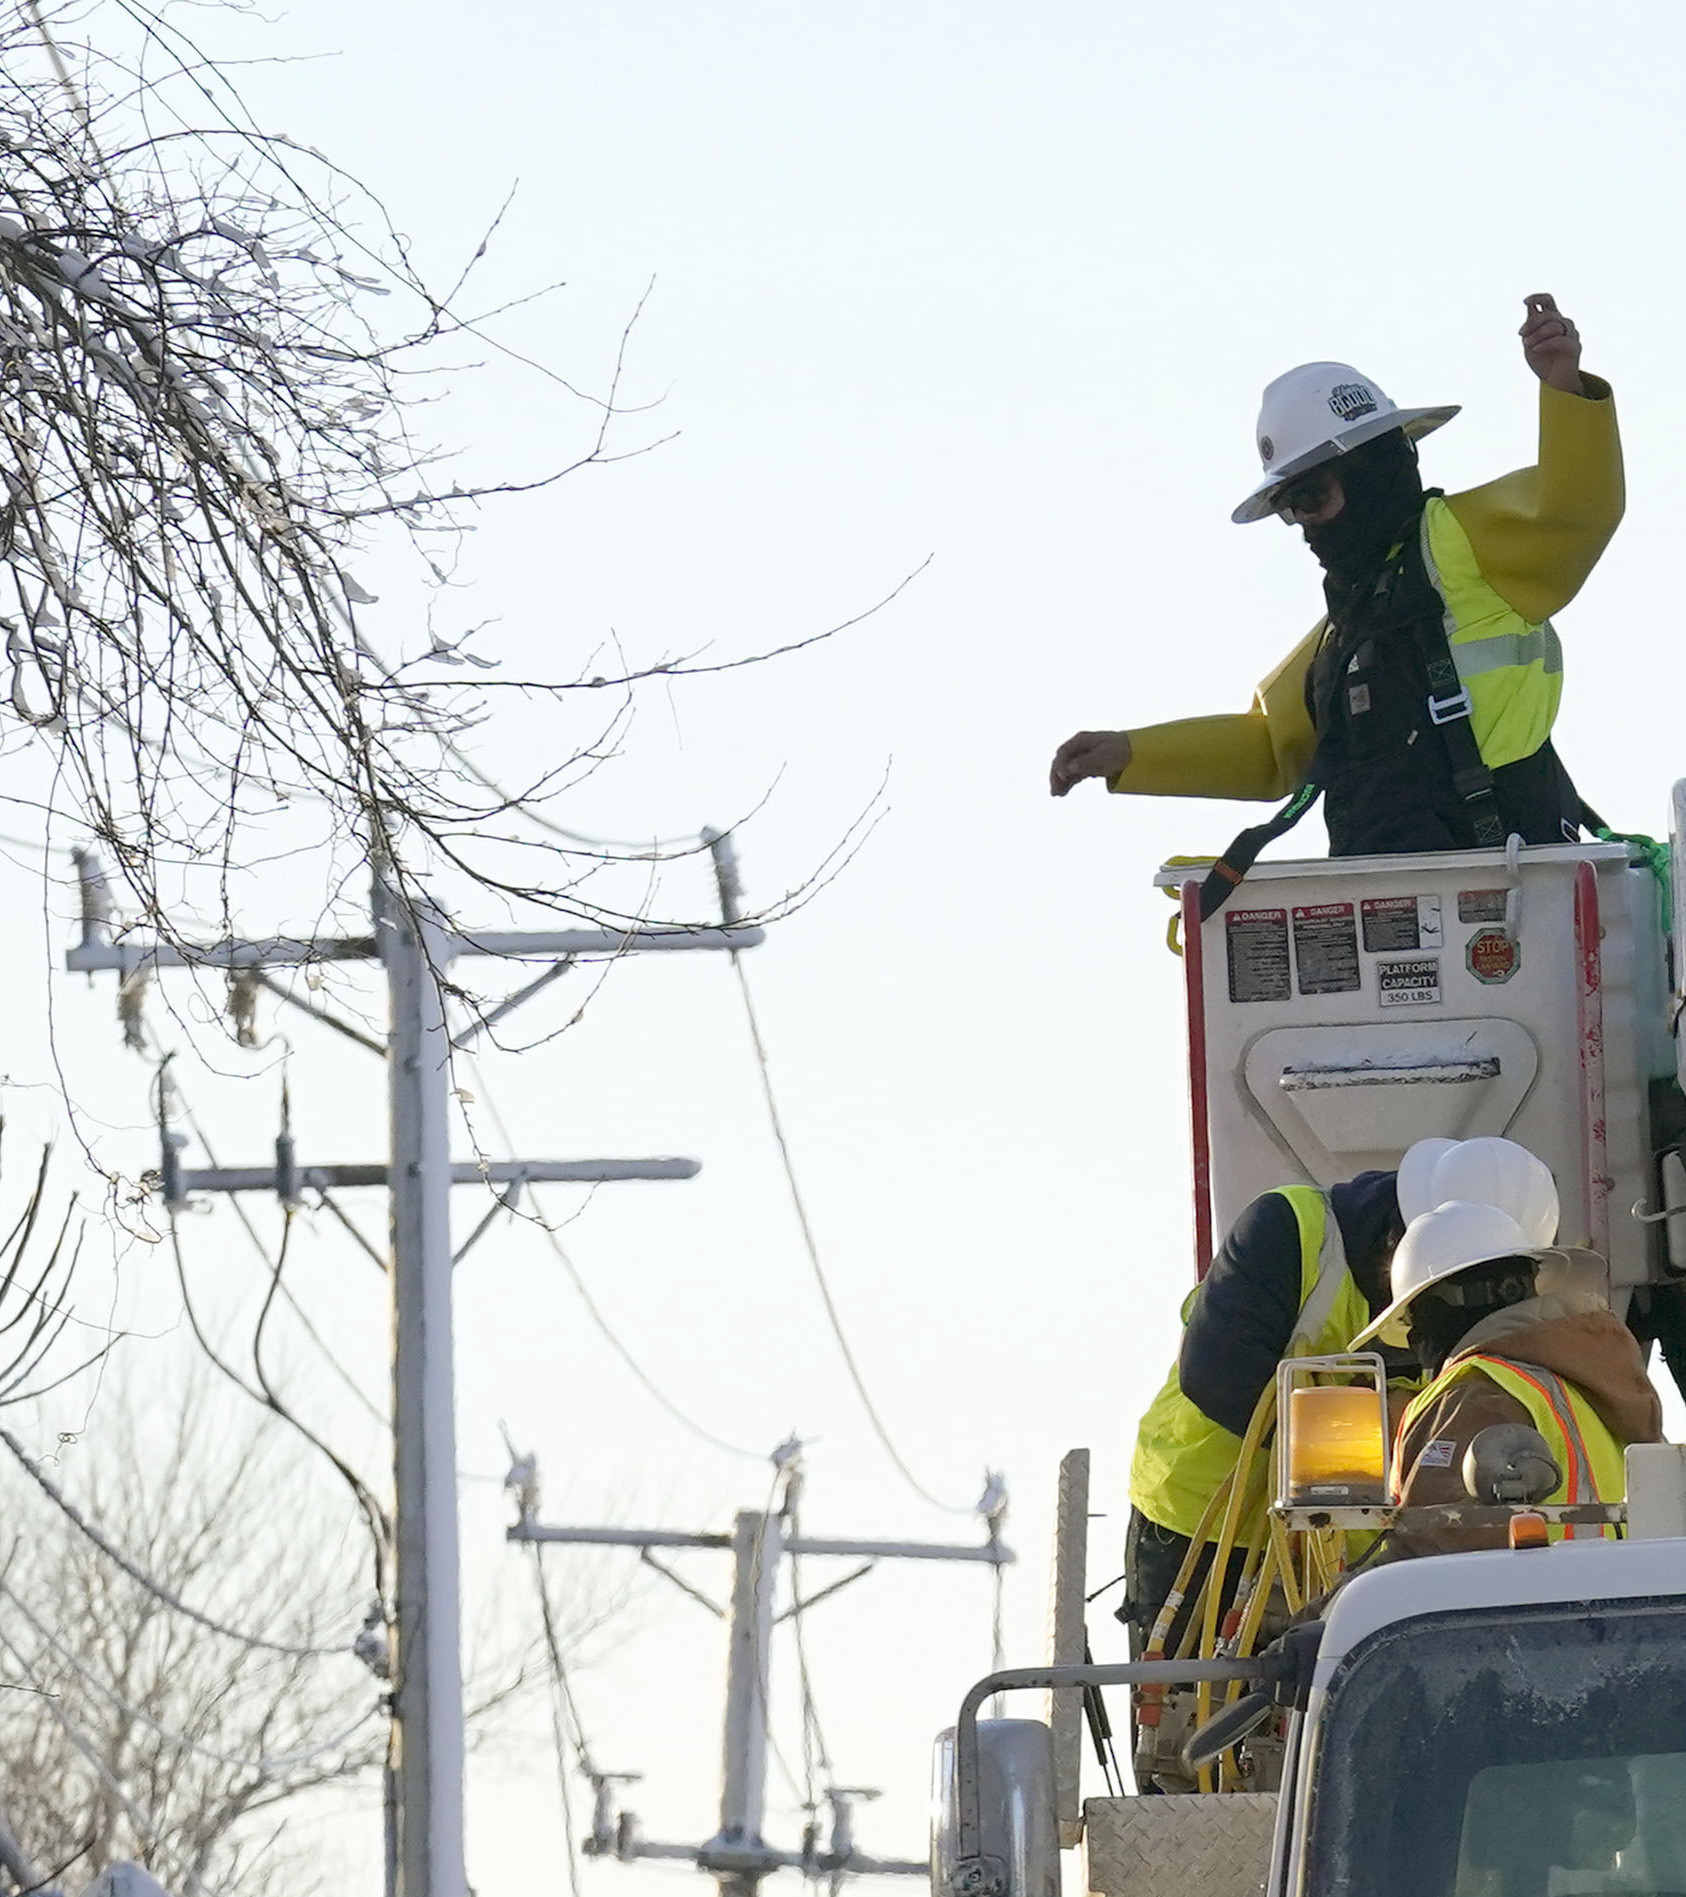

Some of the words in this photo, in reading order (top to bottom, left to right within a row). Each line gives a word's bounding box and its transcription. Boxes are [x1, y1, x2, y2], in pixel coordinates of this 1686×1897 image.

[1242, 912, 1282, 921] DANGER
[1310, 905, 1345, 915] DANGER
[1477, 940, 1509, 954] STOP
[1379, 961, 1438, 975] PLATFORM
[1382, 976, 1436, 989] CAPACITY
[1387, 992, 1409, 1003] 350
[1411, 990, 1433, 1001] LBS
